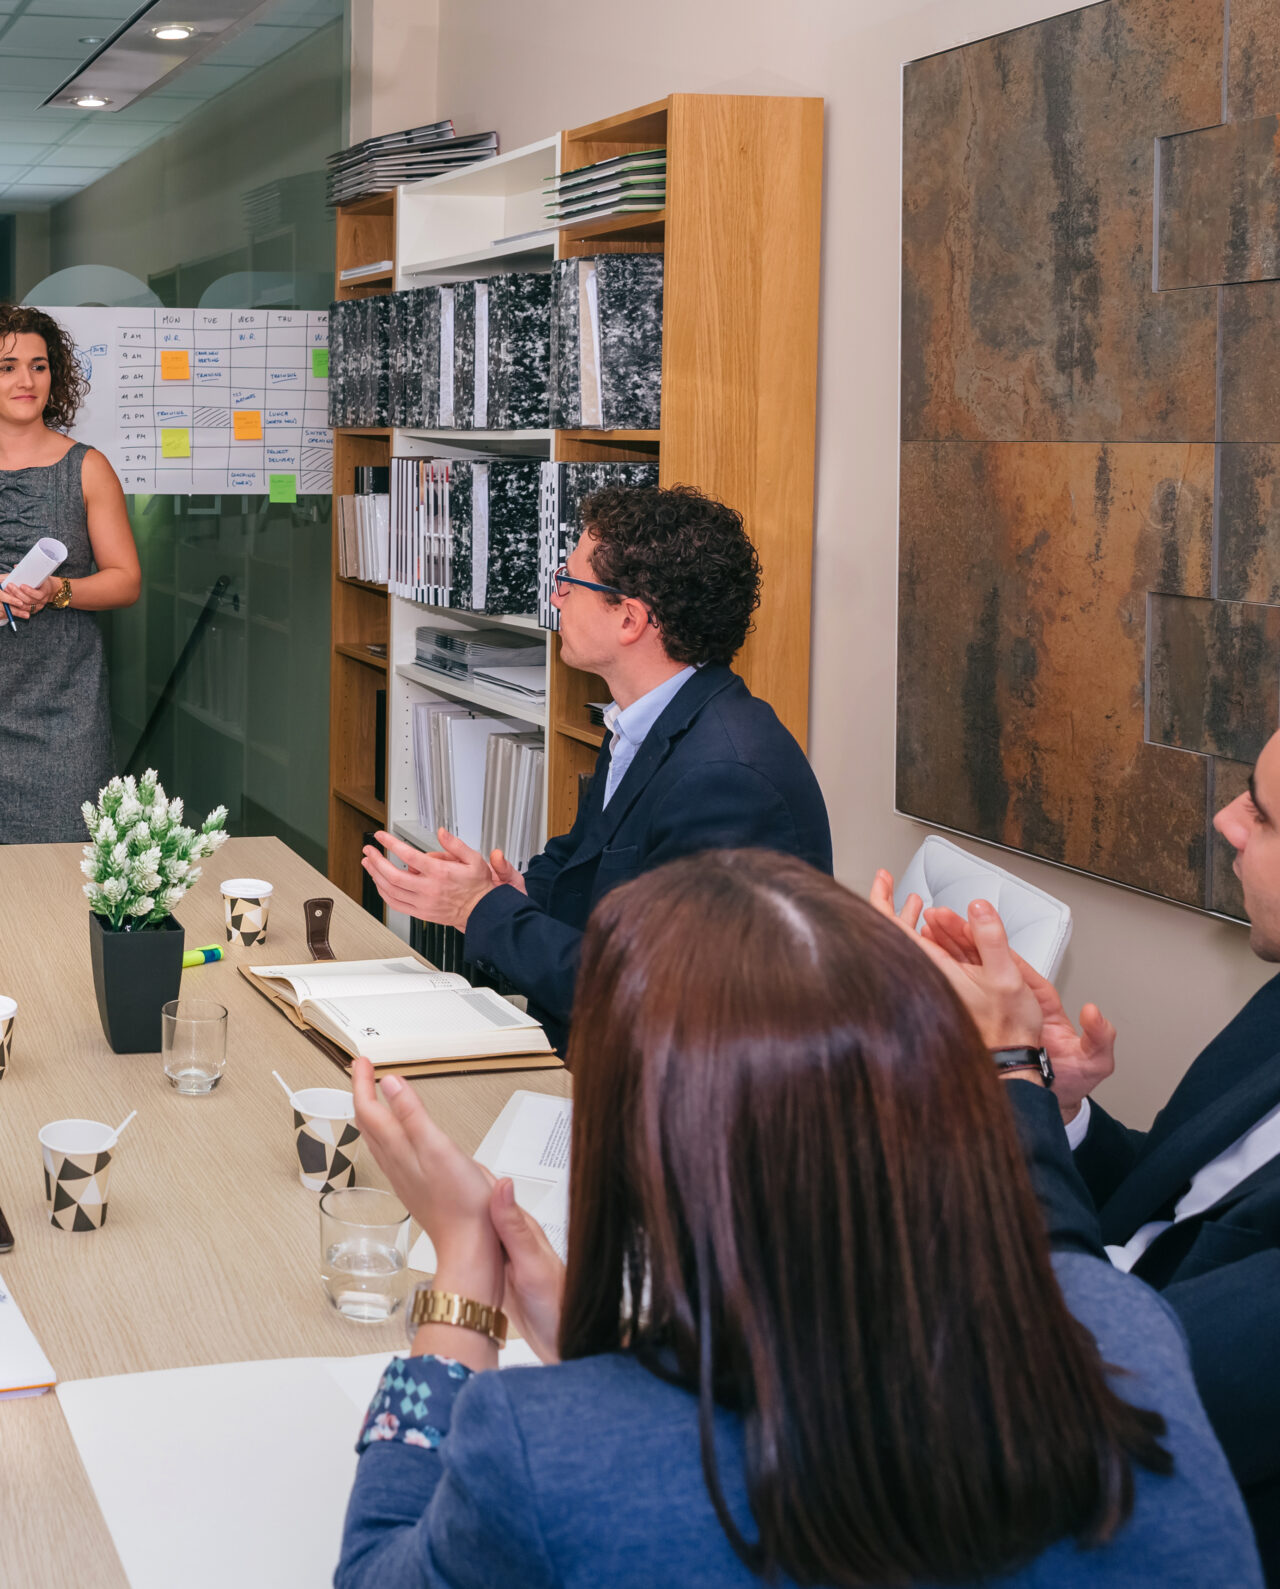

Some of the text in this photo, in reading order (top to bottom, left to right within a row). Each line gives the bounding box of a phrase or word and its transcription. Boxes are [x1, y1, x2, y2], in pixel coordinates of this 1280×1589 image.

[162, 315, 181, 325] MON
[203, 316, 218, 324] TUE
[238, 315, 255, 324] WED
[277, 315, 293, 323] THU
